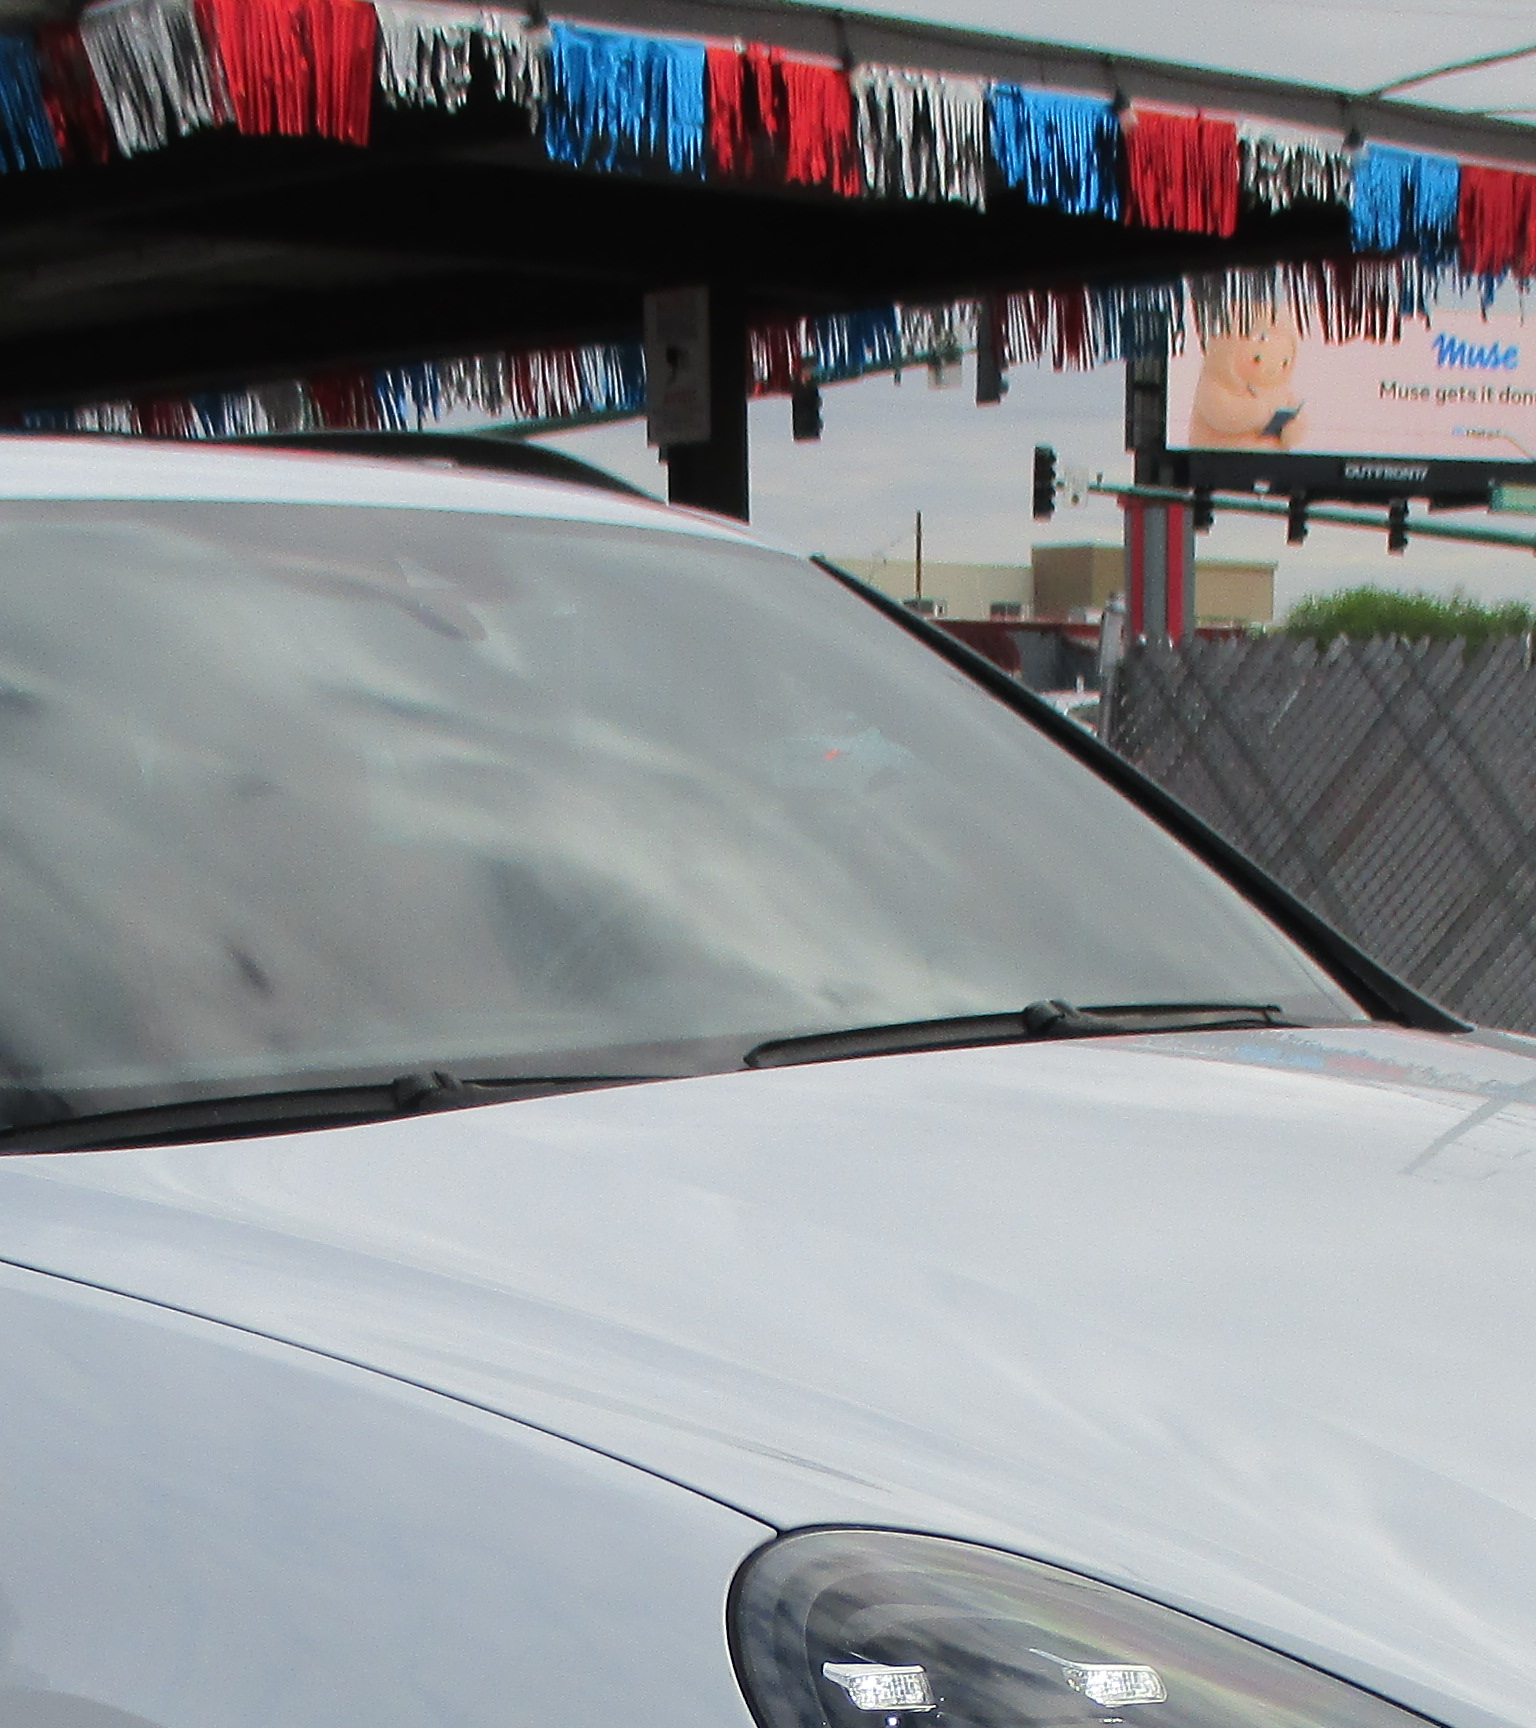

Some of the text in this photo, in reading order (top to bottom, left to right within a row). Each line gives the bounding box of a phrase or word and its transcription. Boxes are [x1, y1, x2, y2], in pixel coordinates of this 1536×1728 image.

[1431, 331, 1520, 370] Muse
[1378, 380, 1430, 401] Muse
[1434, 384, 1477, 406] gets
[1480, 385, 1493, 404] it
